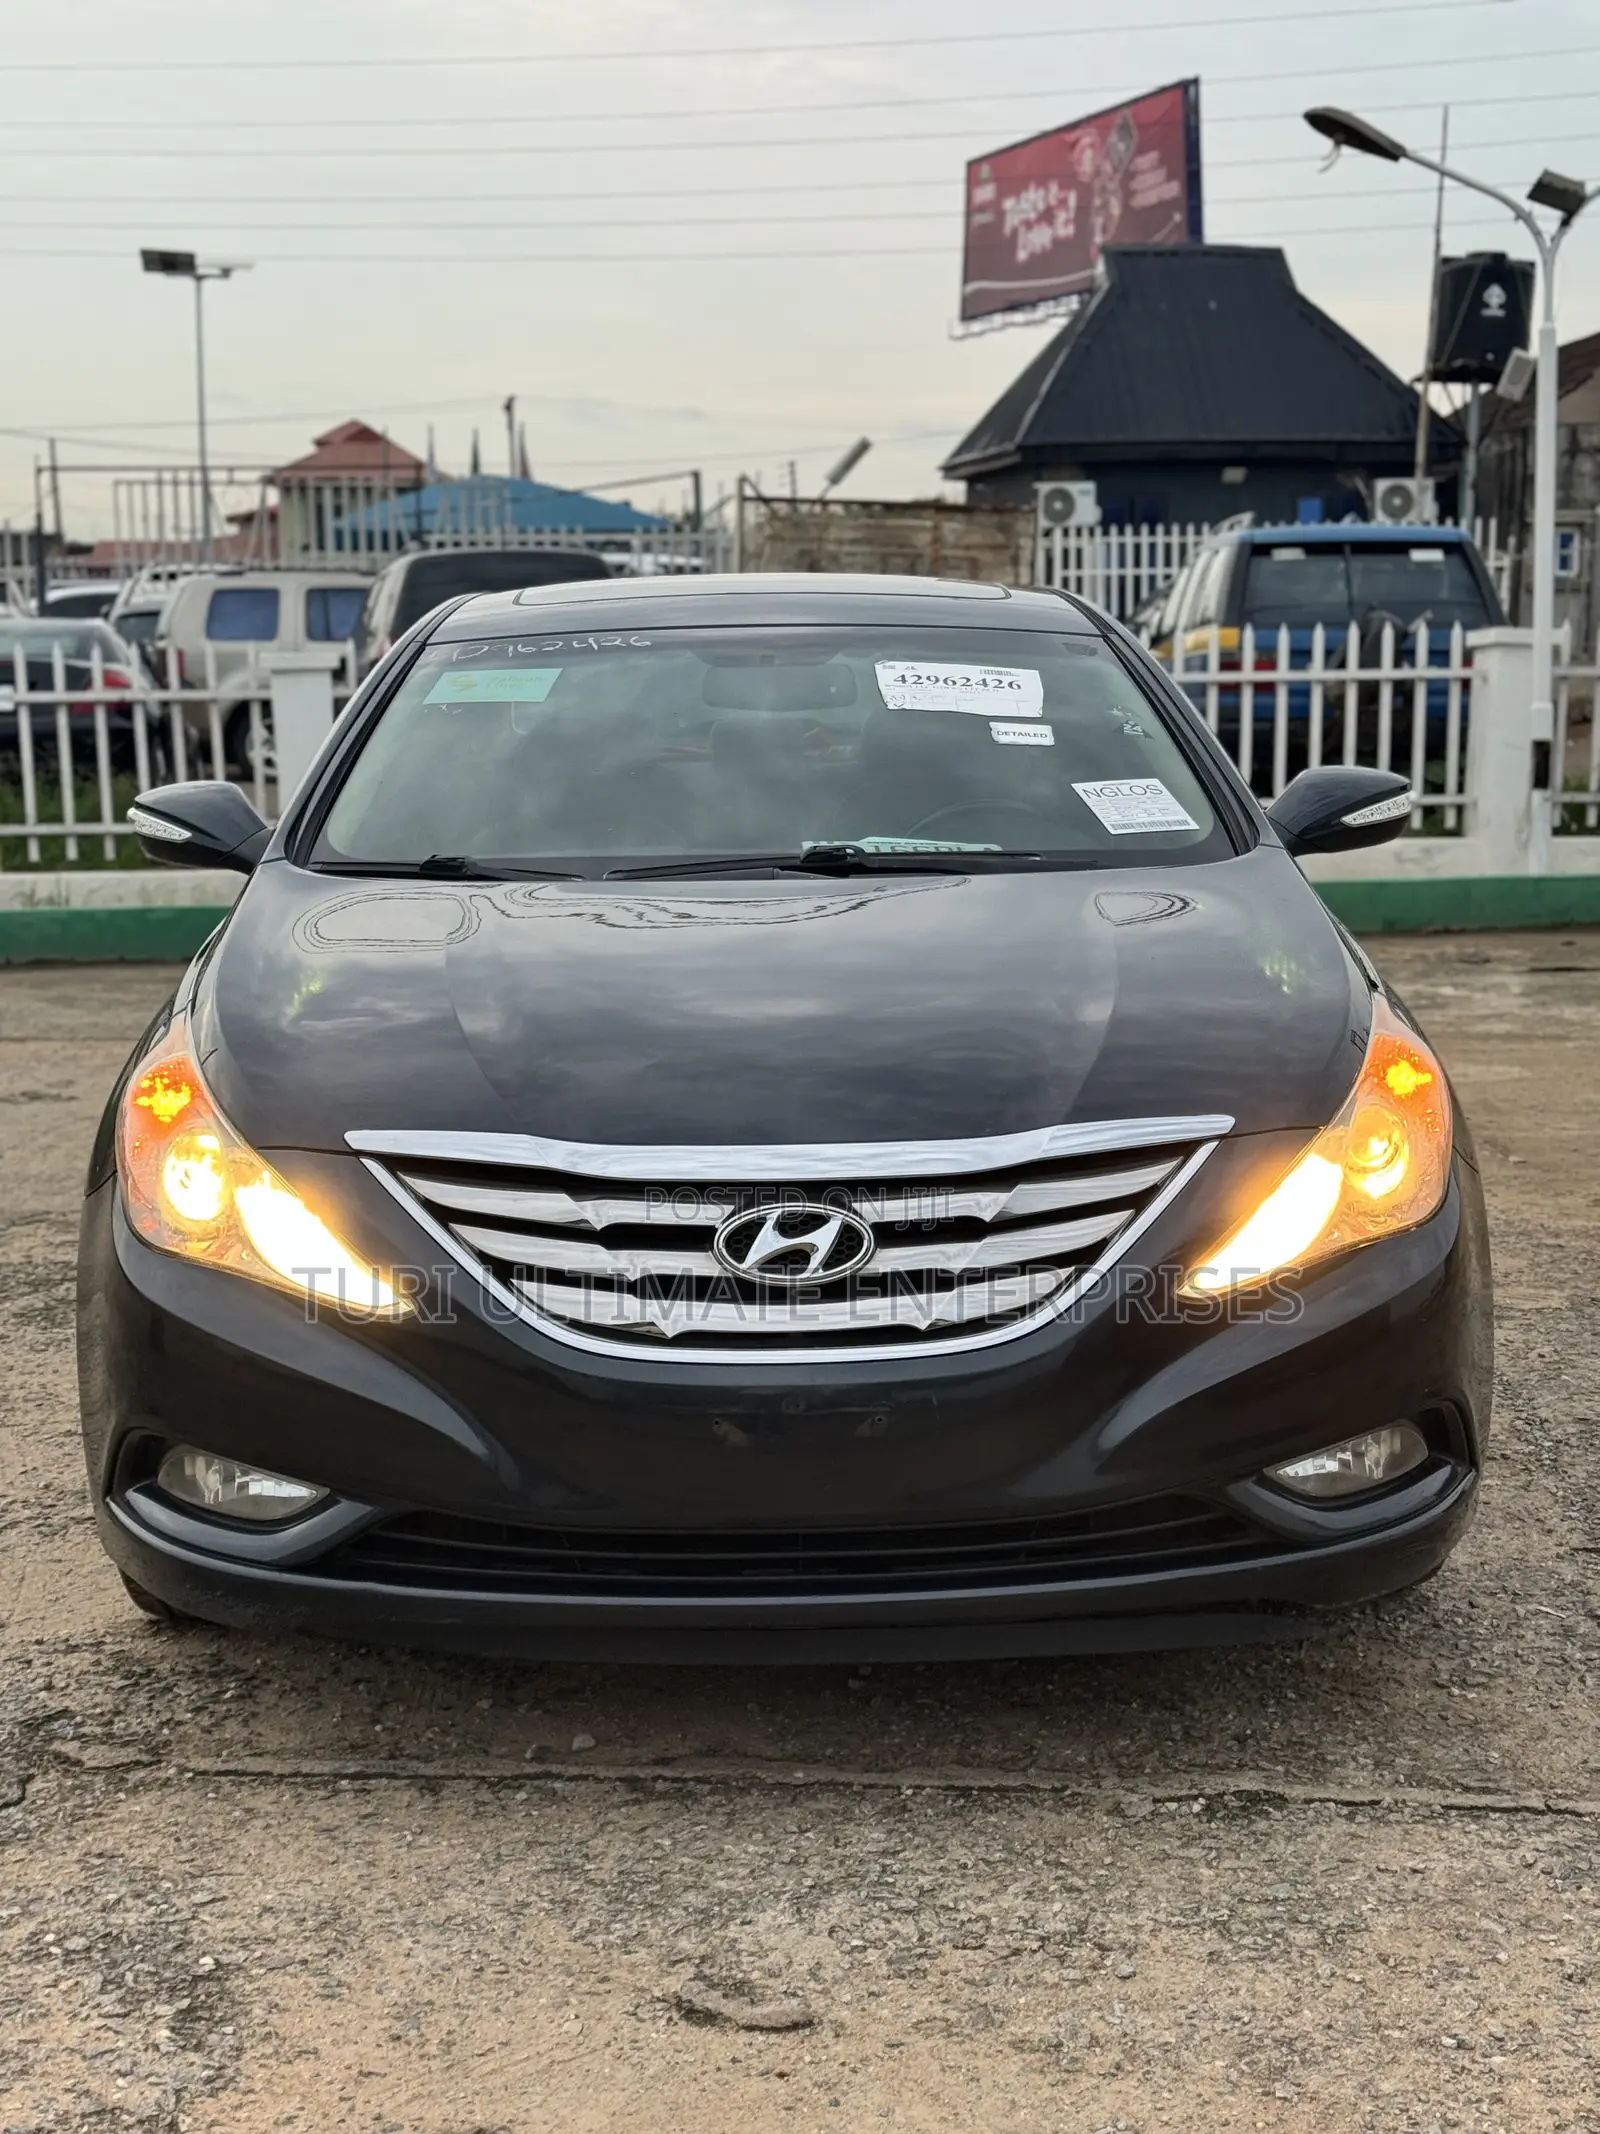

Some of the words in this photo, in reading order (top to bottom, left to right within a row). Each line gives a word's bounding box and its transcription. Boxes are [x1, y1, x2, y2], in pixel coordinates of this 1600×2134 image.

[893, 673, 1022, 691] 42962426
[996, 729, 1048, 739] DETAILED
[1081, 784, 1164, 799] NGLOS
